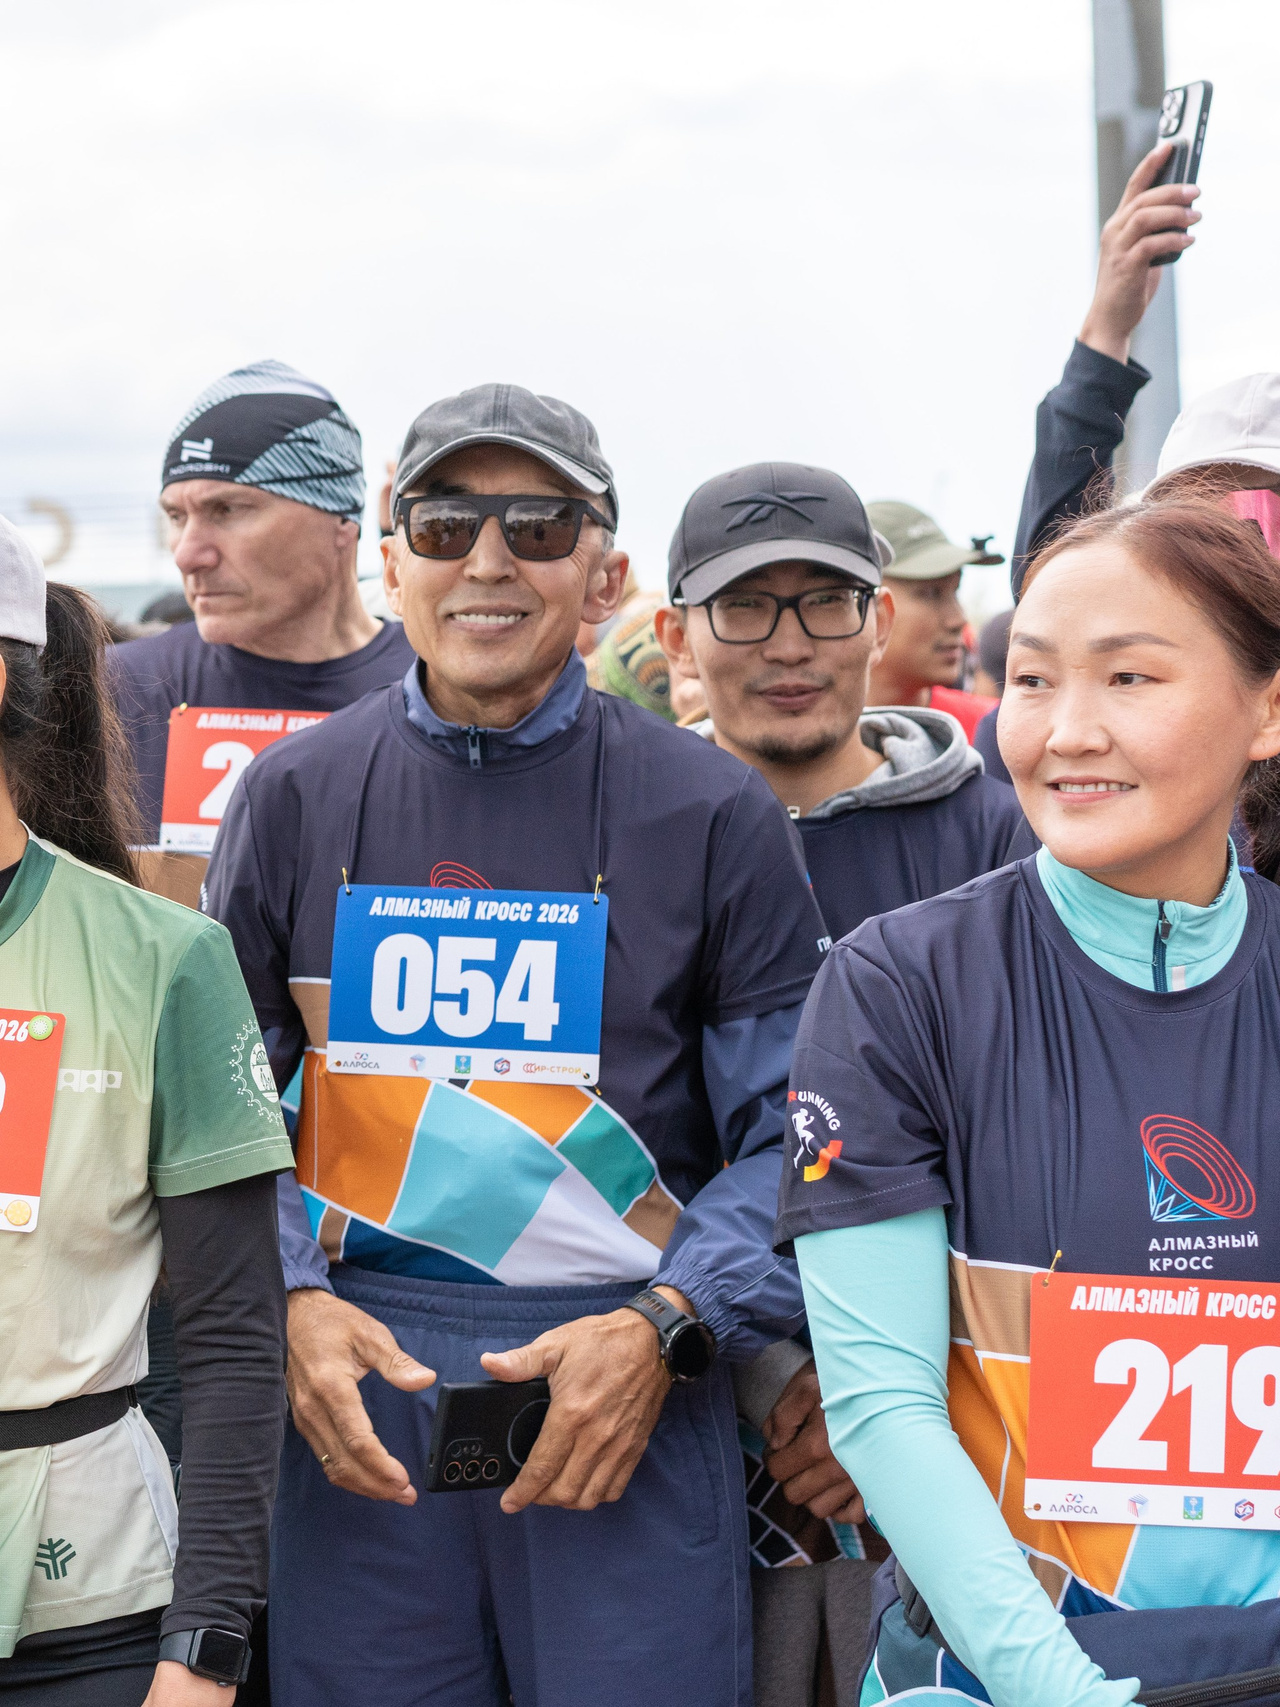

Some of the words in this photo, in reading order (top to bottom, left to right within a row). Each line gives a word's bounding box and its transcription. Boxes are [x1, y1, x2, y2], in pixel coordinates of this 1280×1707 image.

[196, 713, 284, 732] АЛМАЗНЫЙ
[369, 896, 470, 919] АЛМАЗНЫЙ
[475, 901, 532, 922] КРОСС
[536, 903, 579, 924] 2026
[370, 933, 560, 1041] 054
[787, 1090, 841, 1131] RUNNING
[1148, 1230, 1259, 1252] АЛМАЗНЫЙ
[1149, 1256, 1214, 1272] КРОСС
[1070, 1286, 1200, 1316] АЛМАЗНЫЙ
[1205, 1292, 1277, 1320] КРОСС
[1092, 1338, 1280, 1476] 219
